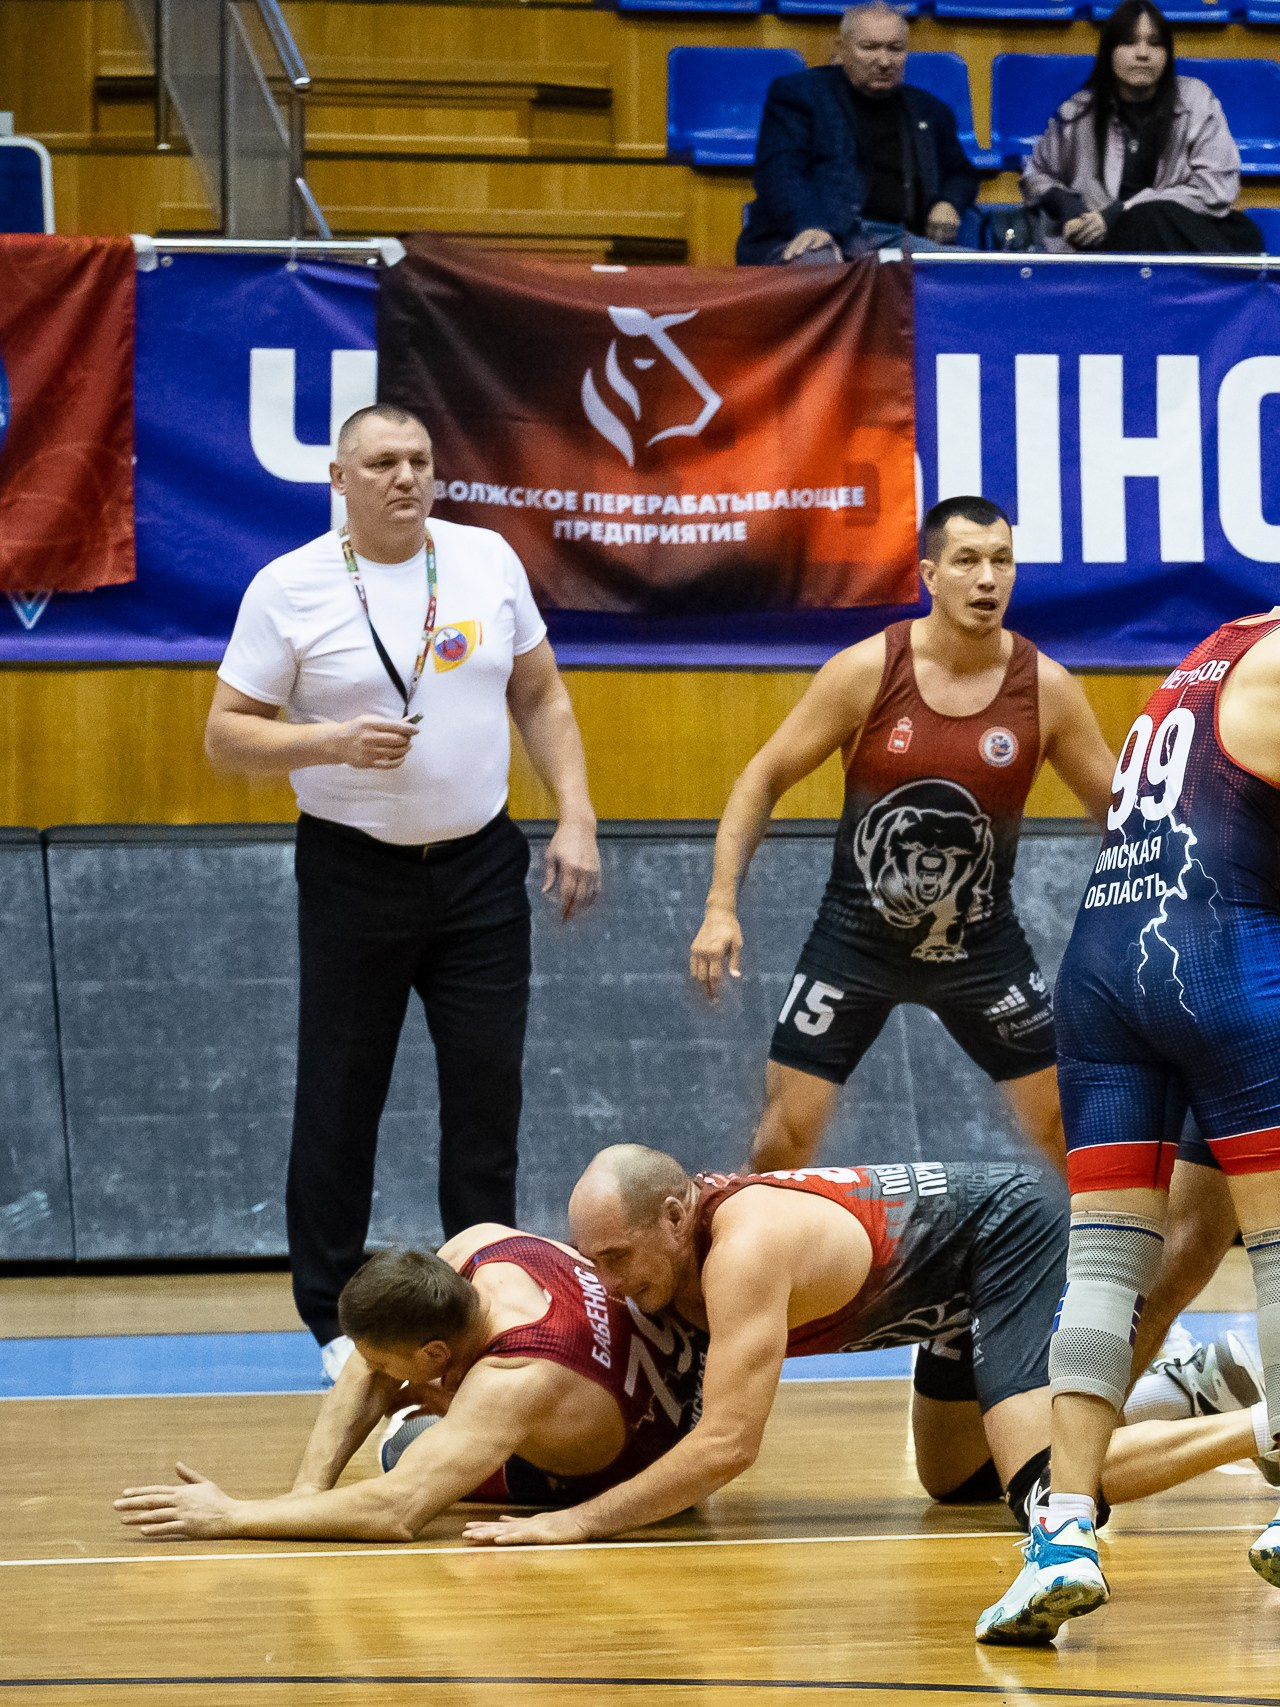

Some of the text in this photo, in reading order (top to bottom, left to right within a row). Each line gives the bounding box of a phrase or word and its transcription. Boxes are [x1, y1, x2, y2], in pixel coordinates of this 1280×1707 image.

[433, 479, 866, 515] ВОЛЖСКОЕ ПЕРЕРАБАТЫВАЮЩЕЕ
[552, 519, 748, 546] ПРЕДПРИЯТИЕ
[1107, 707, 1196, 831] 99
[1094, 835, 1162, 874] ОМСКАЯ
[1084, 872, 1168, 910] ОБЛАСТЬ
[778, 972, 845, 1037] 15
